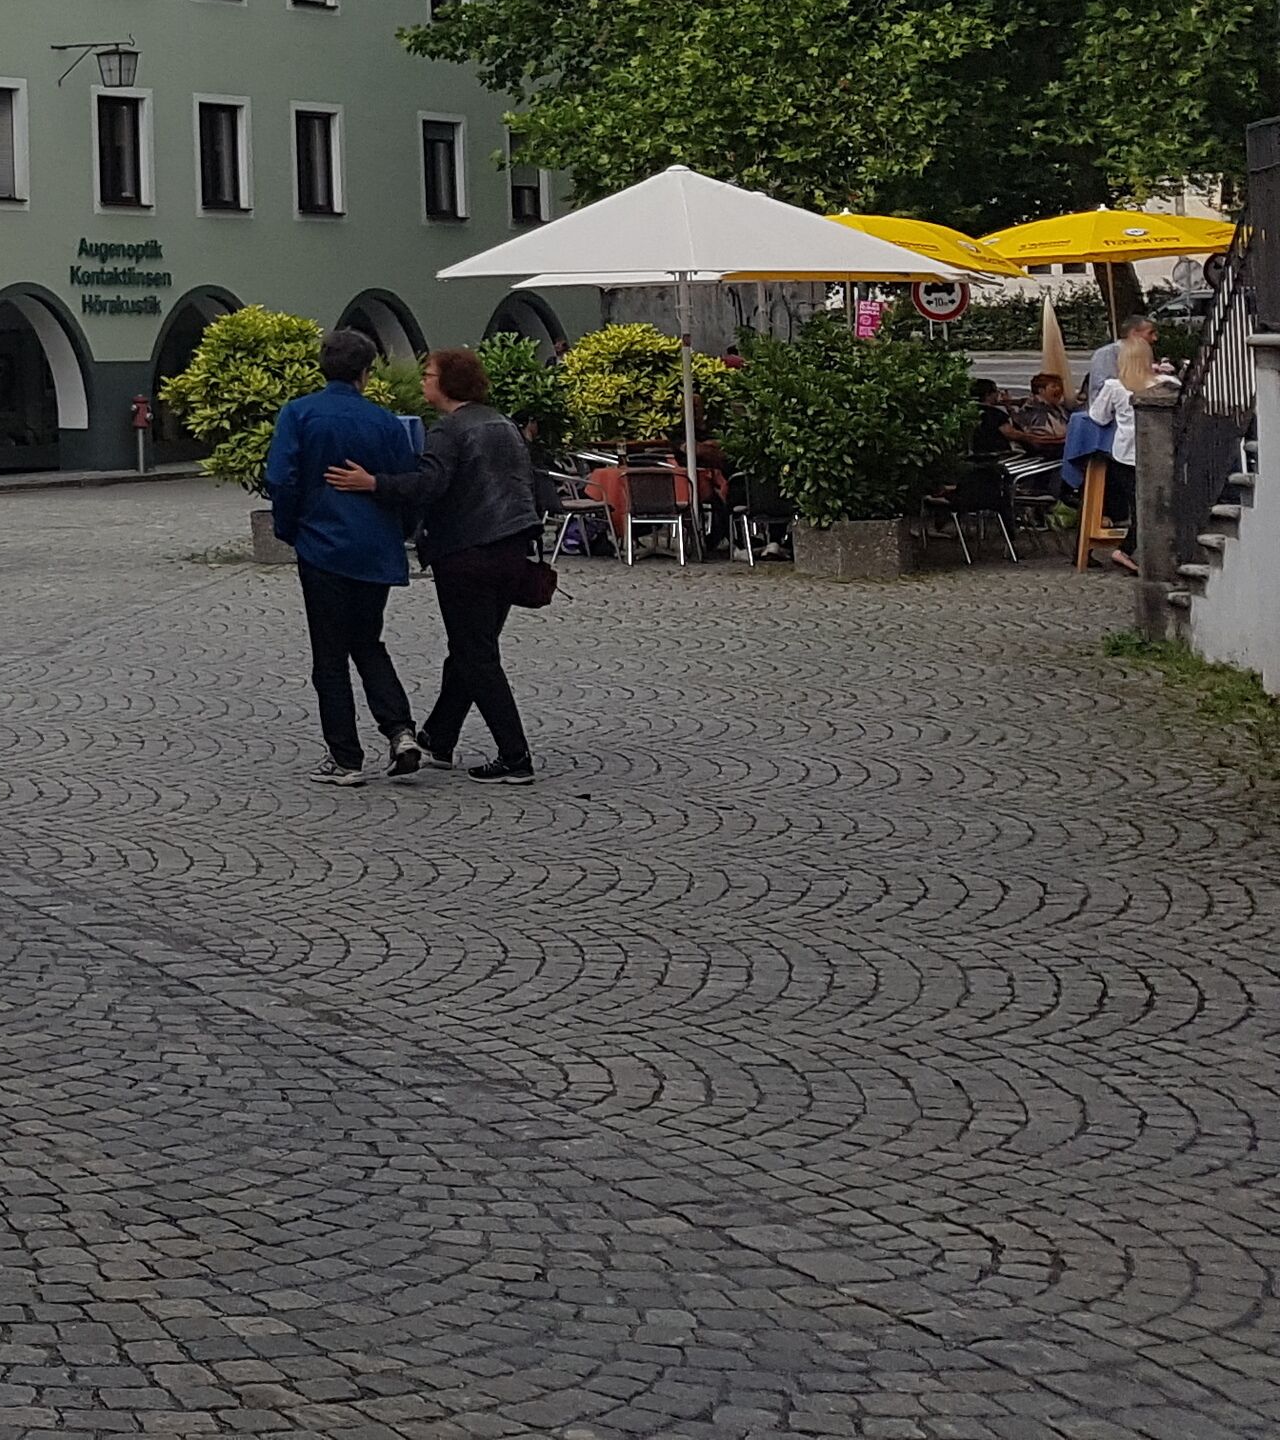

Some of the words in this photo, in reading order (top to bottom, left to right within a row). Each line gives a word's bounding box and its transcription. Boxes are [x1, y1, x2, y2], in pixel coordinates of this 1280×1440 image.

[78, 237, 163, 264] Augenoptik
[69, 265, 172, 287] Kontaktlinsen
[81, 294, 162, 315] Hörakustik
